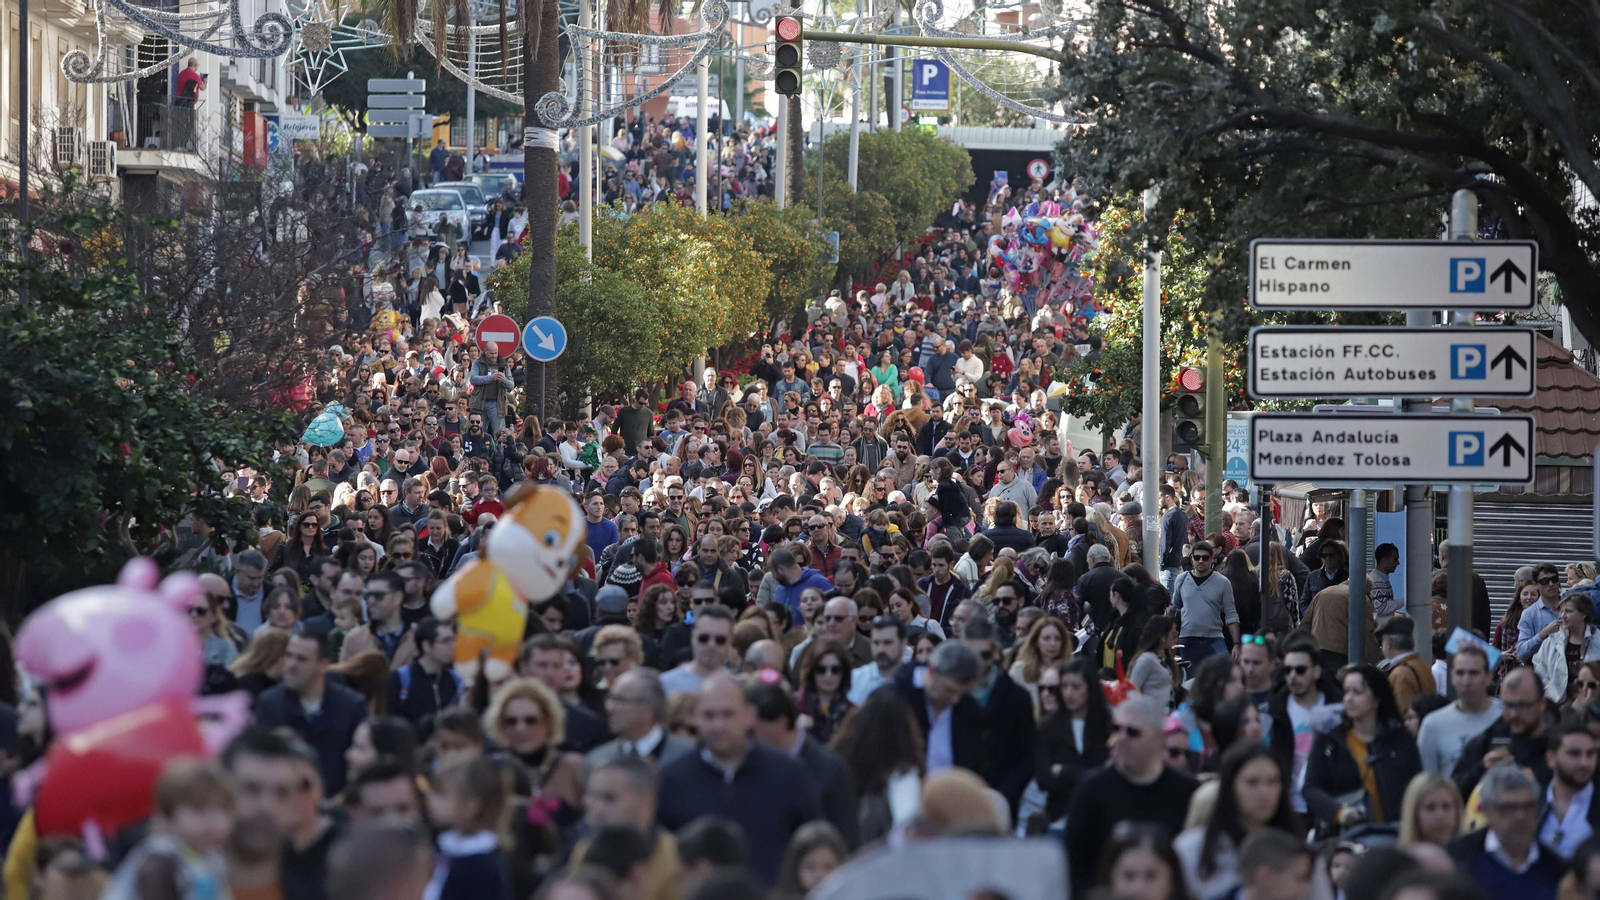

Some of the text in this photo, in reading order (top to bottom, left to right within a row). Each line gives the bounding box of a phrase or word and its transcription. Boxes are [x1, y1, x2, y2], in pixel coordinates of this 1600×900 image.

[922, 64, 938, 86] P
[1260, 256, 1351, 270] El Carmen
[1457, 261, 1481, 291] P
[1260, 279, 1330, 295] Hispano
[1260, 345, 1400, 358] Estación FF.CC.
[1457, 347, 1482, 377] P
[1260, 367, 1437, 381] Estación Autobuses
[1258, 430, 1399, 443] Plaza Andalucía
[464, 441, 473, 453] 5
[1455, 434, 1480, 464] P
[1258, 451, 1411, 466] Menéndez Tolosa
